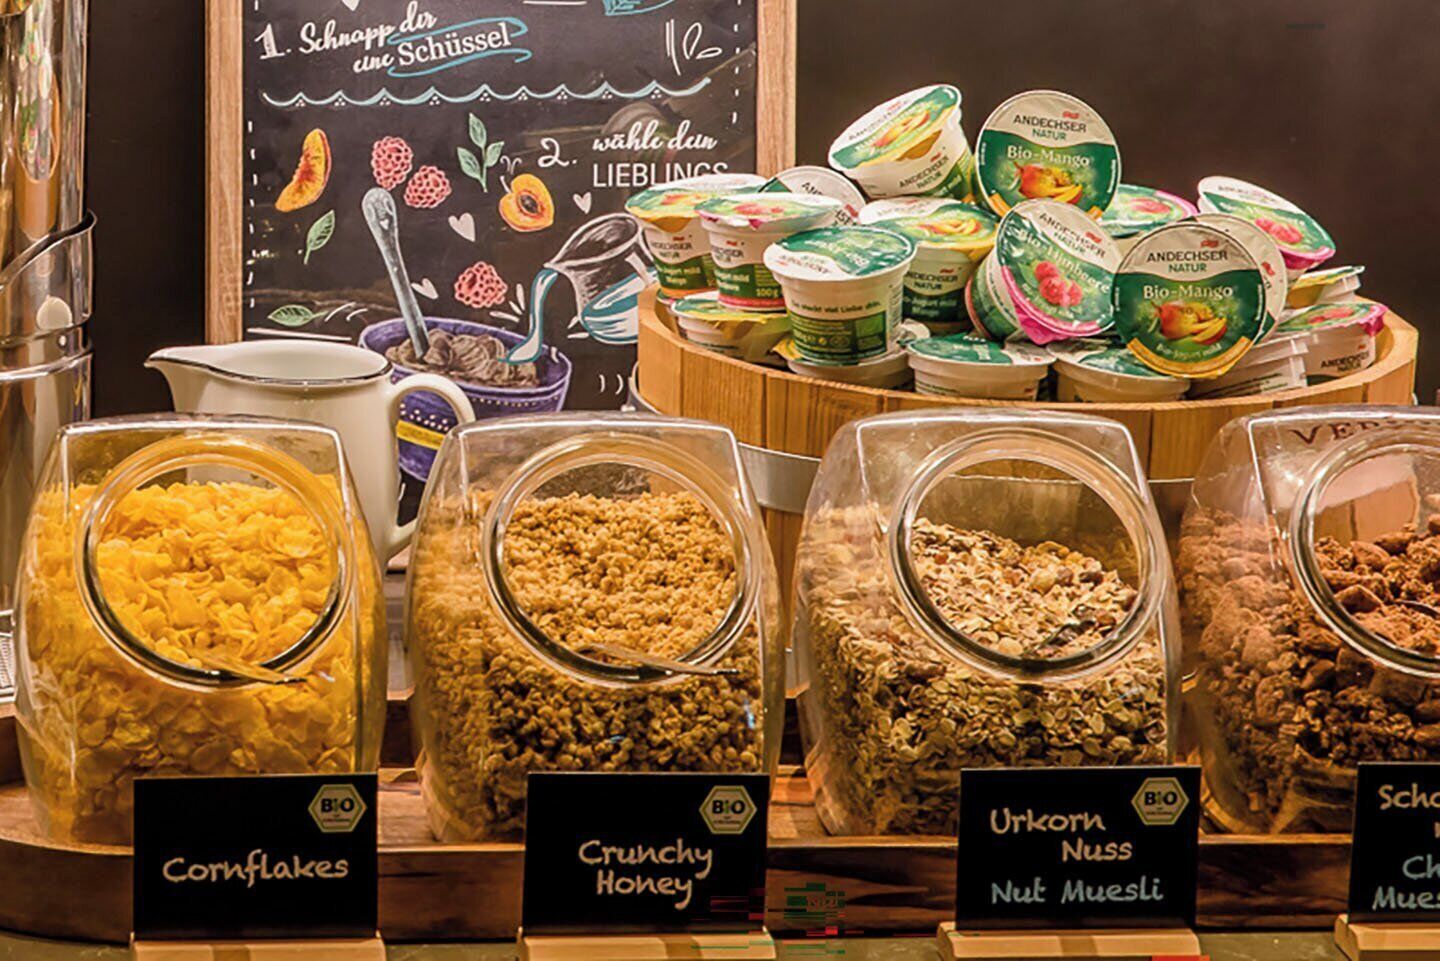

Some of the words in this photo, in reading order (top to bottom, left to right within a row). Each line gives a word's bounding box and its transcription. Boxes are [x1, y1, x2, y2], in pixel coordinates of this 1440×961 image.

[254, 23, 292, 60] 1.
[298, 19, 396, 54] Schnapp
[353, 52, 395, 73] eine
[398, 22, 511, 67] Schüssel
[1013, 114, 1087, 133] ANDECHSER
[1032, 129, 1067, 140] NATUR
[537, 137, 577, 168] 2.
[592, 120, 664, 152] wähle
[667, 119, 718, 151] dein
[1007, 144, 1090, 169] Bio-Mango
[1146, 250, 1228, 262] ANDECHSER
[1168, 263, 1207, 273] NATUR
[1143, 284, 1234, 300] Bio-Mango
[990, 807, 1106, 834] Urkorn
[578, 838, 712, 879] Crunchy
[1062, 837, 1133, 862] Nuss
[162, 848, 349, 888] Cornflakes
[596, 869, 693, 910] Honey
[991, 876, 1047, 904] Nut
[1061, 875, 1164, 905] Muesli
